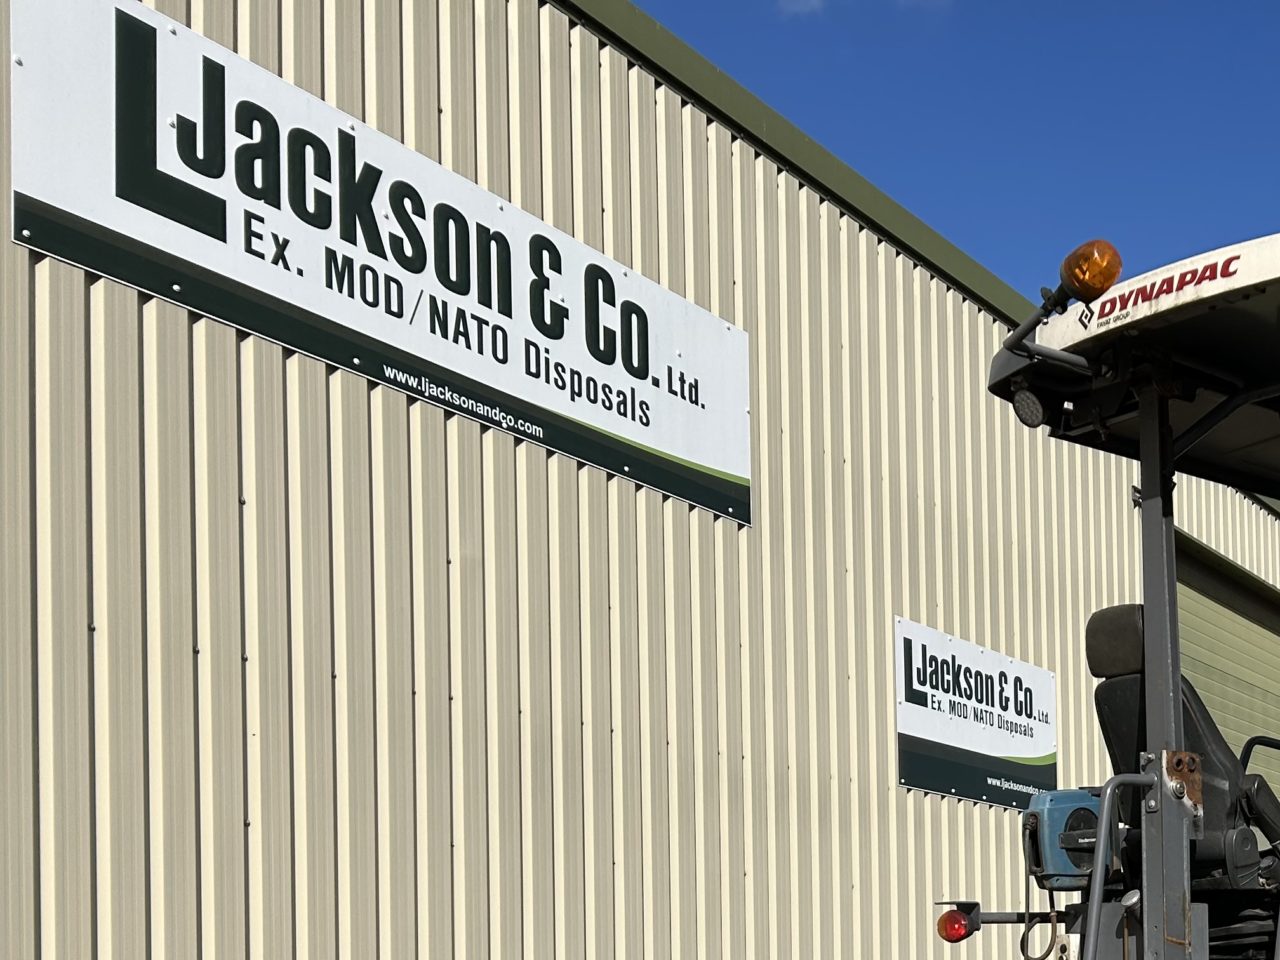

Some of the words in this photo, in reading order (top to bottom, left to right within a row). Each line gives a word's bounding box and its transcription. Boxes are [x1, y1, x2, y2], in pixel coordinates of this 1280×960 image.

[244, 208, 304, 277] Ex.
[524, 338, 650, 427] Disposals
[529, 233, 569, 340] &
[584, 263, 660, 388] Co.
[667, 365, 705, 409] Ltd.
[1097, 254, 1241, 320] DYNAPAC
[383, 364, 544, 438] www.ljacksonandco.com
[931, 693, 945, 713] Ex.
[998, 714, 1034, 738] Disposals
[998, 670, 1010, 712] &
[1014, 676, 1036, 720] Co.
[1038, 709, 1050, 725] Ltd.
